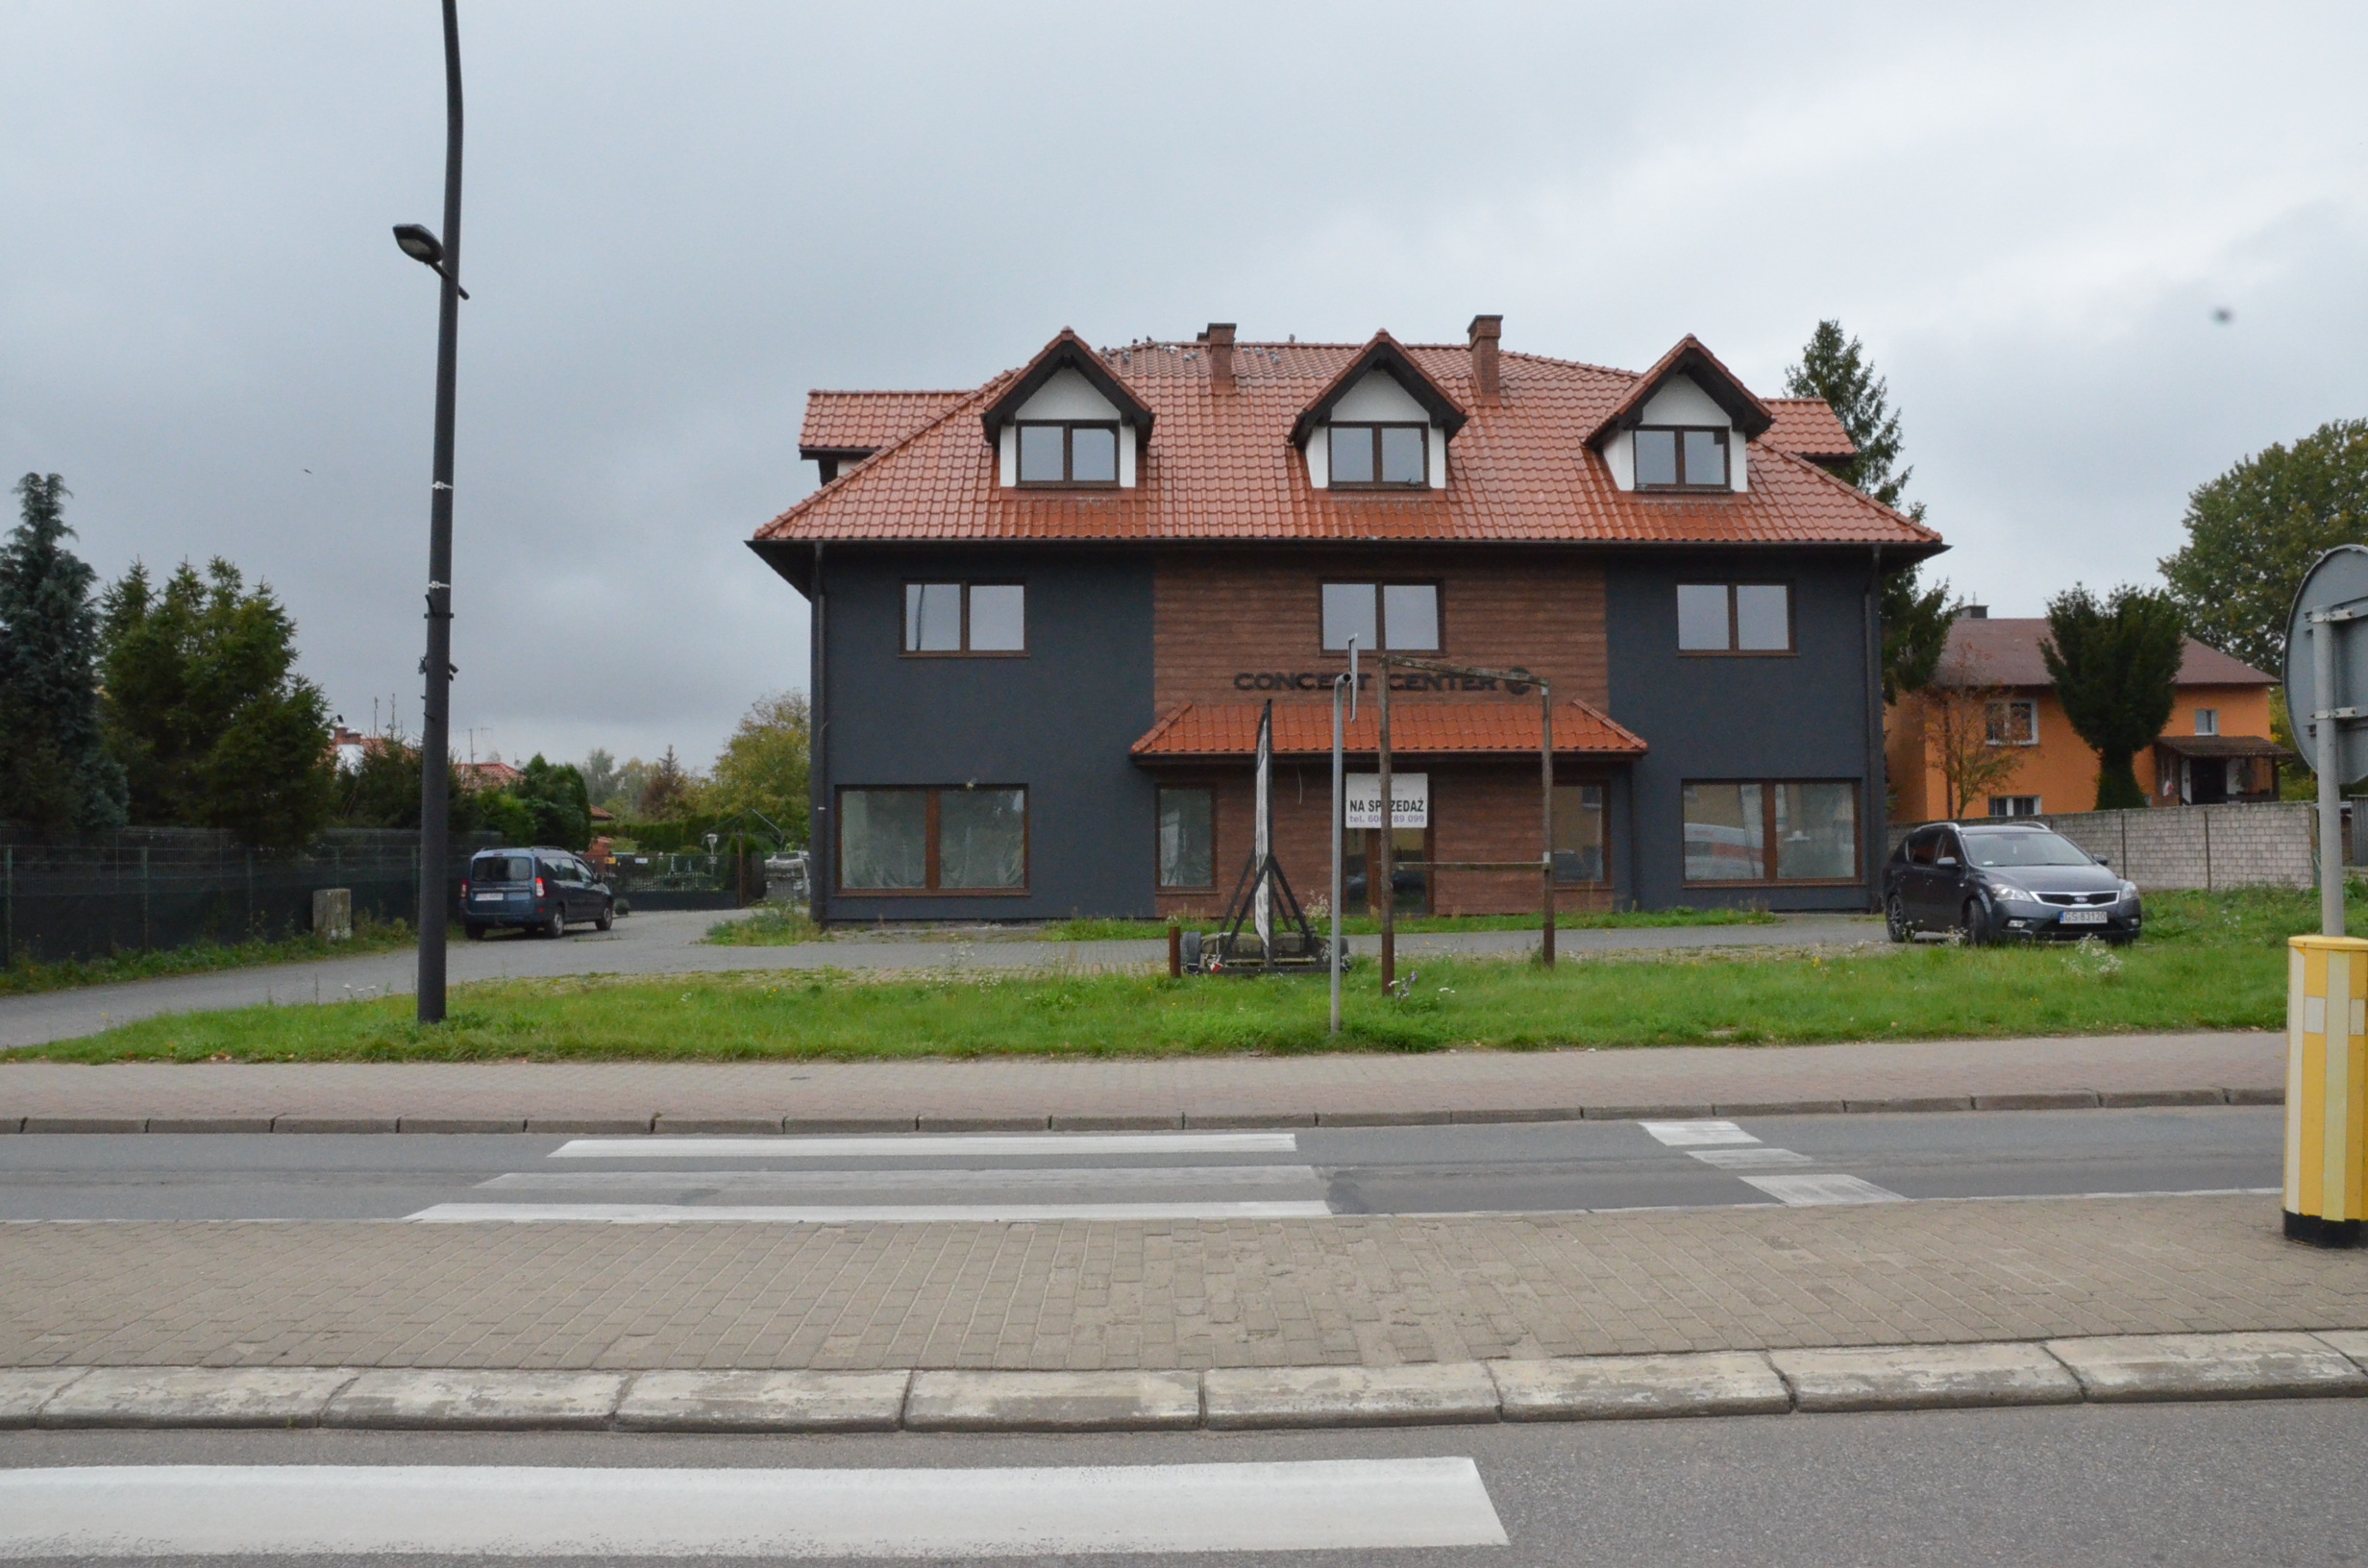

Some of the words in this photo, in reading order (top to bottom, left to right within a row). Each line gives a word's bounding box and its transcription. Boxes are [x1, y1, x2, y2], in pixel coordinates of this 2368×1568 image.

[1234, 674, 1372, 691] CONCET
[1349, 799, 1365, 813] NA
[1368, 796, 1424, 813] SPZEDAŻ
[1349, 815, 1365, 823] tel.
[1407, 815, 1424, 823] 099
